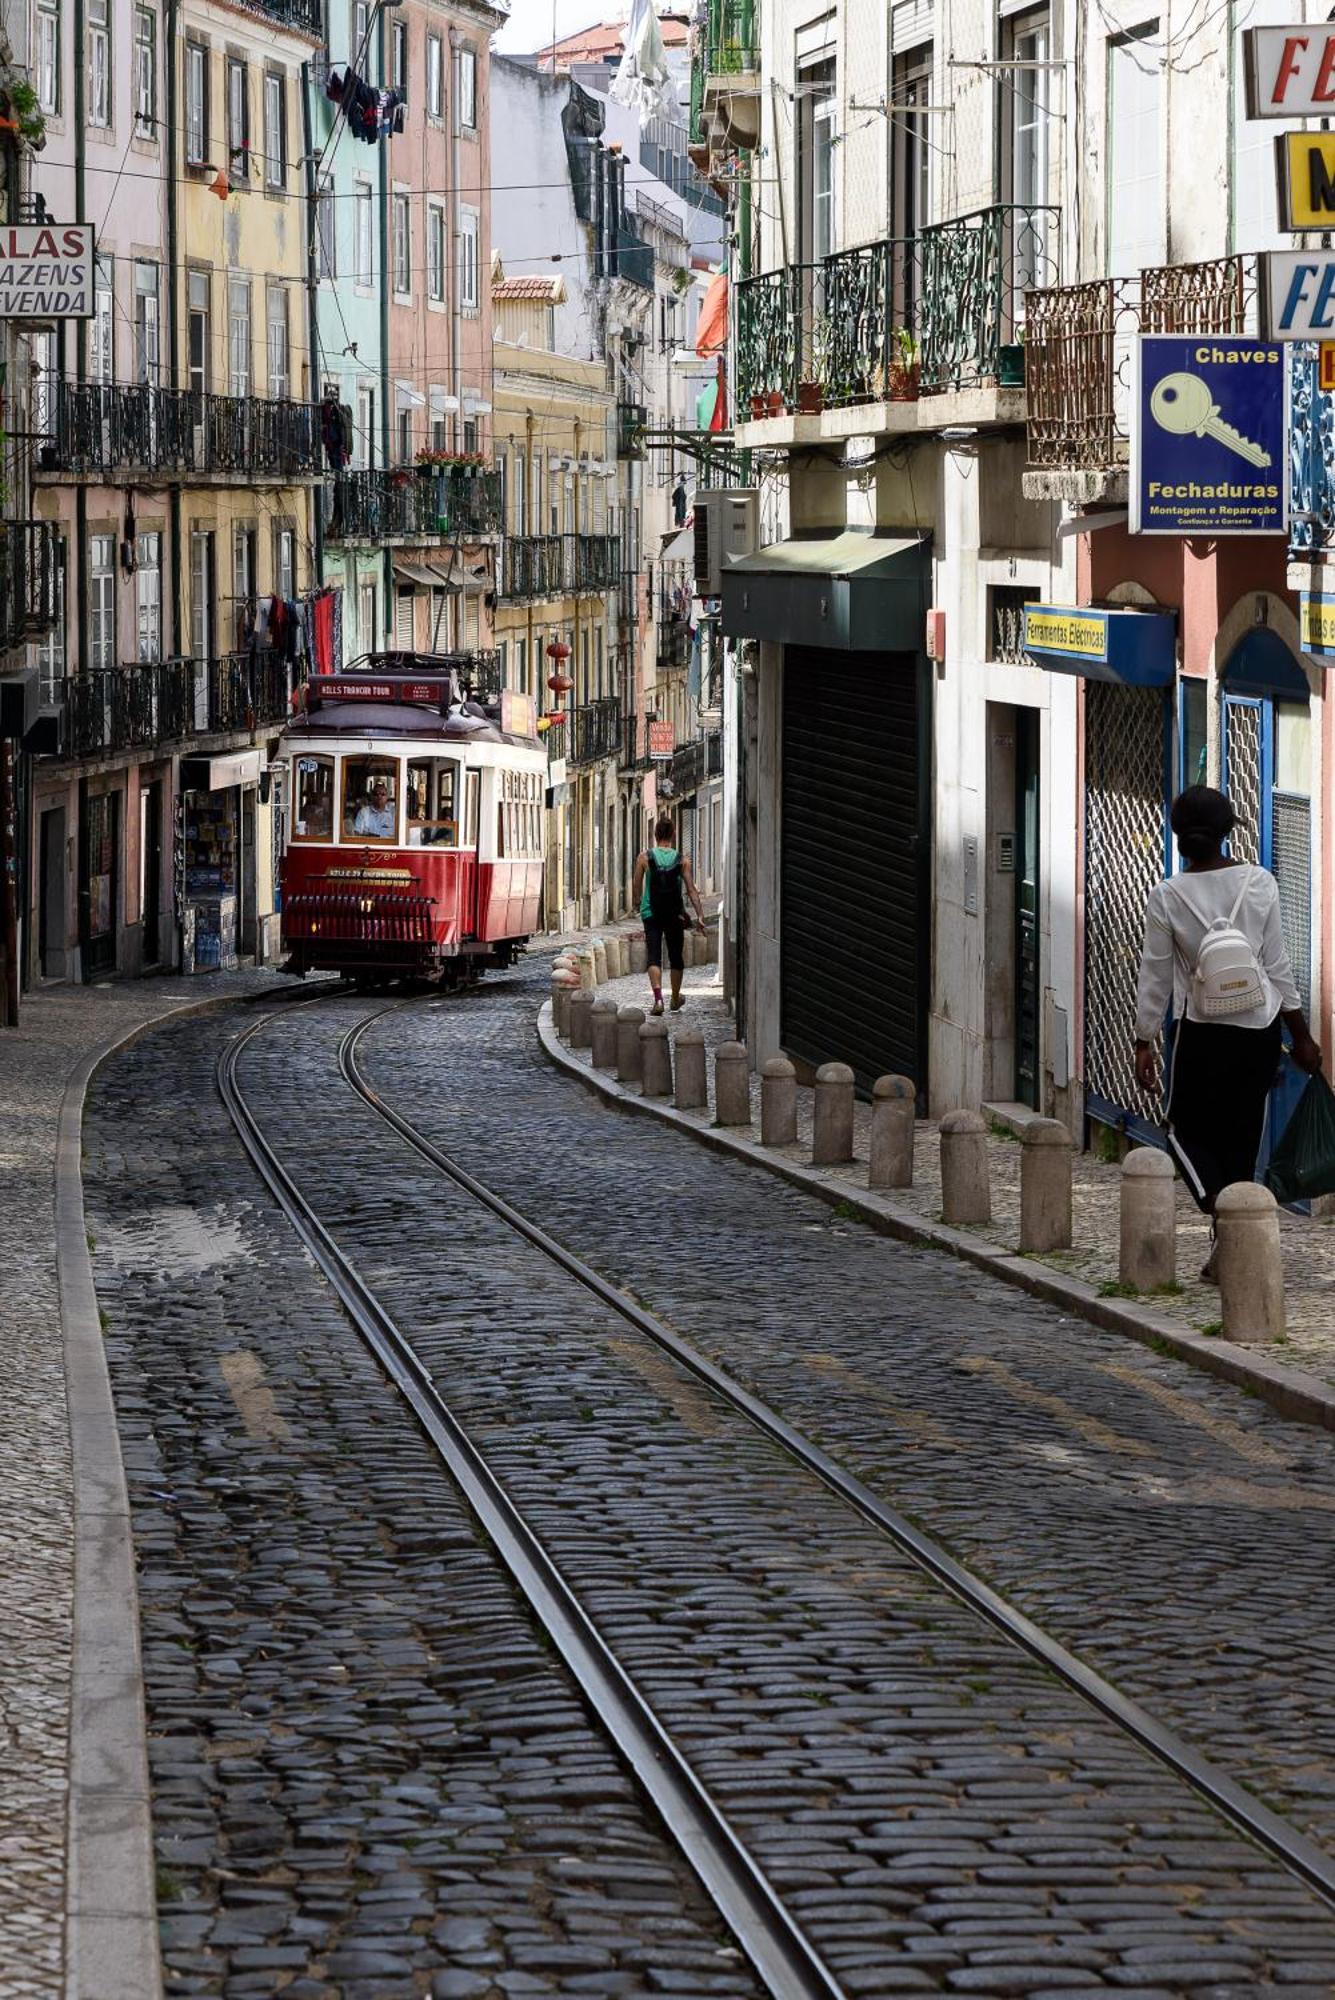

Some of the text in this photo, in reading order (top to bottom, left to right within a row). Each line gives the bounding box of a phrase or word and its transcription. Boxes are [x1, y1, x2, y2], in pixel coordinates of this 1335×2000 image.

[0, 229, 85, 259] LAS
[0, 291, 86, 313] VENDA
[1195, 347, 1280, 364] Chaves
[1149, 482, 1279, 499] Fechaduras
[1149, 506, 1207, 516] Montagem
[1219, 506, 1277, 516] Reparação
[1026, 616, 1105, 648] Ferramentas Eléctricas
[322, 686, 342, 694] HILLS
[372, 687, 390, 696] TOUR
